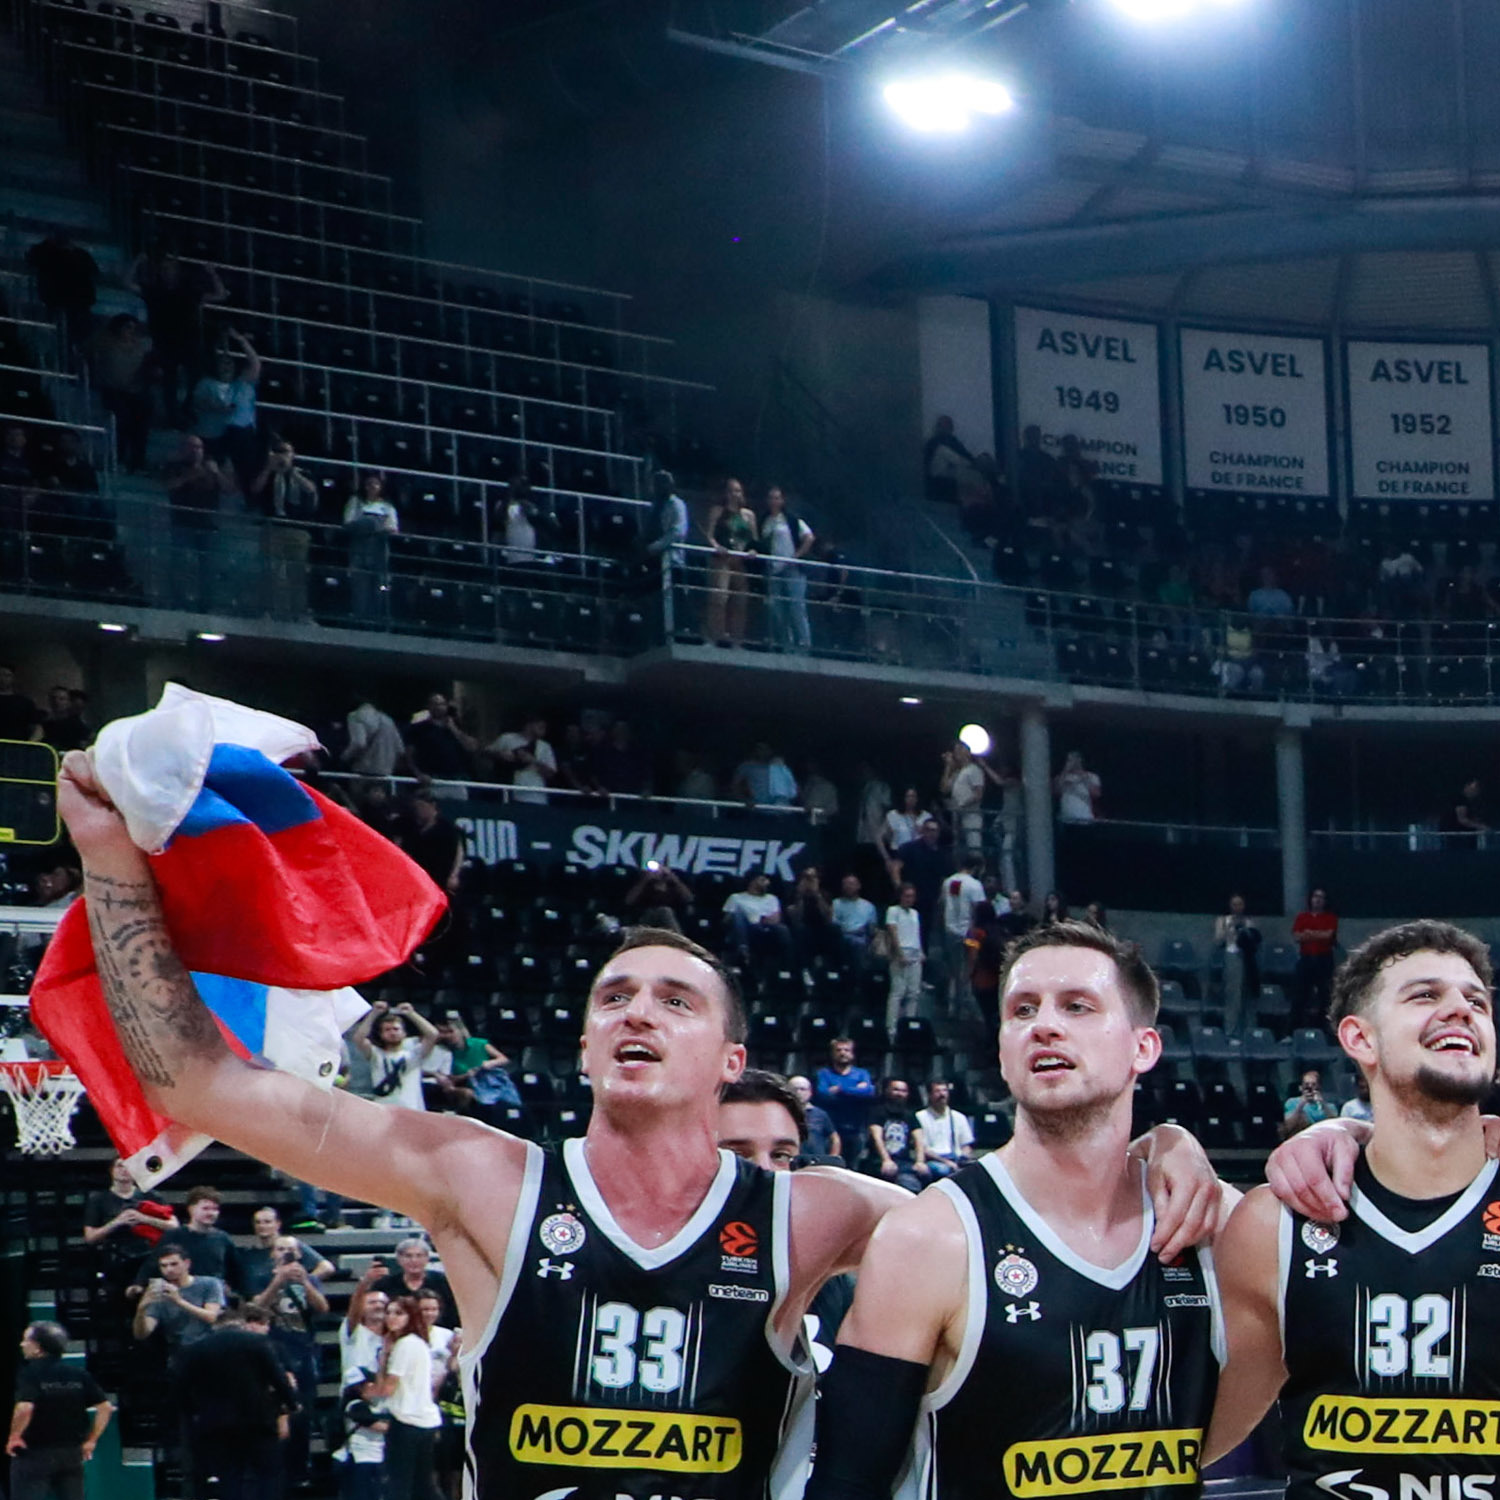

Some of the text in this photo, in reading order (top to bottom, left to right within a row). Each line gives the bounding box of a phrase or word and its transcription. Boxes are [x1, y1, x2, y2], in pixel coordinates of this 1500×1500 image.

[1036, 327, 1136, 363] ASVEL
[1203, 348, 1303, 379] ASVEL
[1370, 359, 1469, 385] ASVEL
[1055, 386, 1120, 414] 1949
[1222, 404, 1286, 428] 1950
[1390, 414, 1452, 436] 1952
[1209, 451, 1304, 470] CHAMPION
[1376, 461, 1470, 476] CHAMPION
[1211, 470, 1304, 490] DE FRANCE
[1379, 479, 1470, 496] DE FRANCE
[592, 1301, 688, 1393] 33
[1368, 1293, 1452, 1378] 32
[1086, 1327, 1160, 1414] 37
[516, 1413, 737, 1464] MOZZART
[1014, 1442, 1200, 1489] MOZZAR
